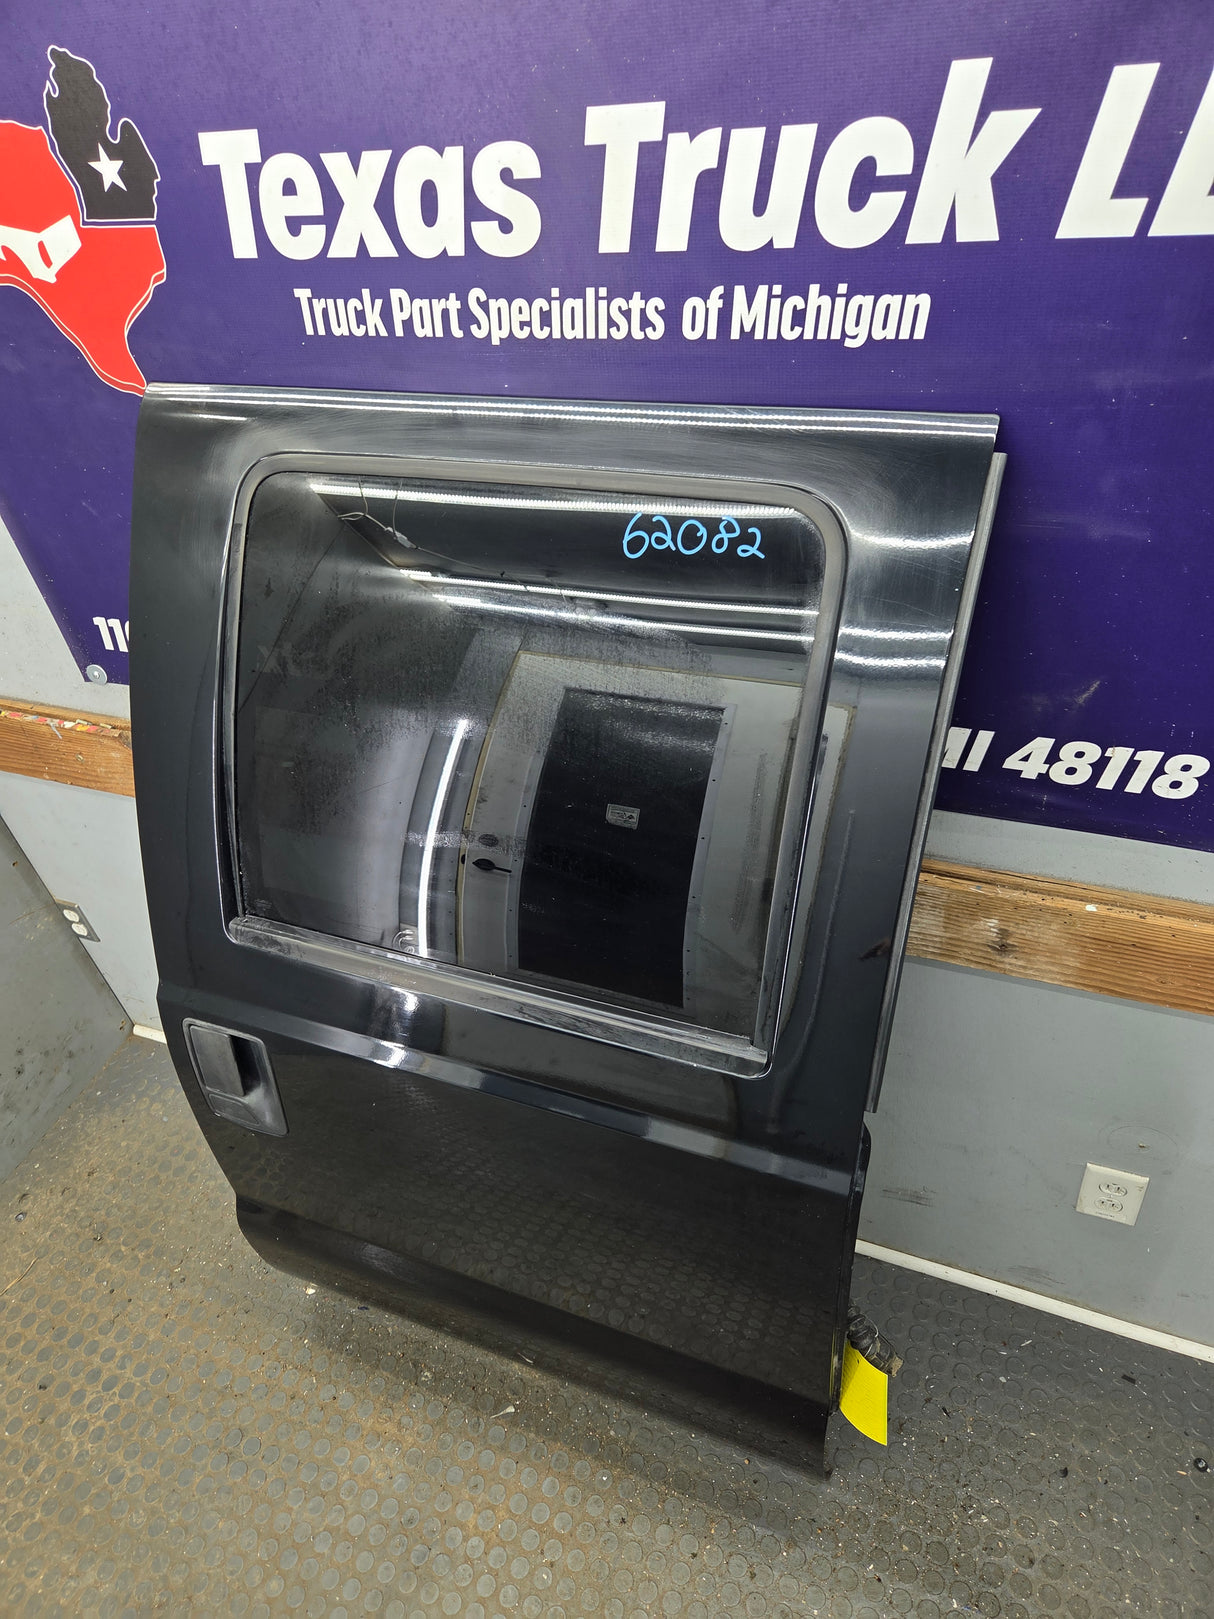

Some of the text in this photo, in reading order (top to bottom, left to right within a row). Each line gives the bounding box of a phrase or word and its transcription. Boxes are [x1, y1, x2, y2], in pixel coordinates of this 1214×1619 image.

[197, 127, 543, 261] Texas
[583, 56, 1043, 254] Truck
[293, 283, 932, 349] Truck Part Specialists of Michigan
[622, 511, 766, 560] 62082
[92, 616, 130, 653] 11
[1002, 736, 1211, 800] 48118
